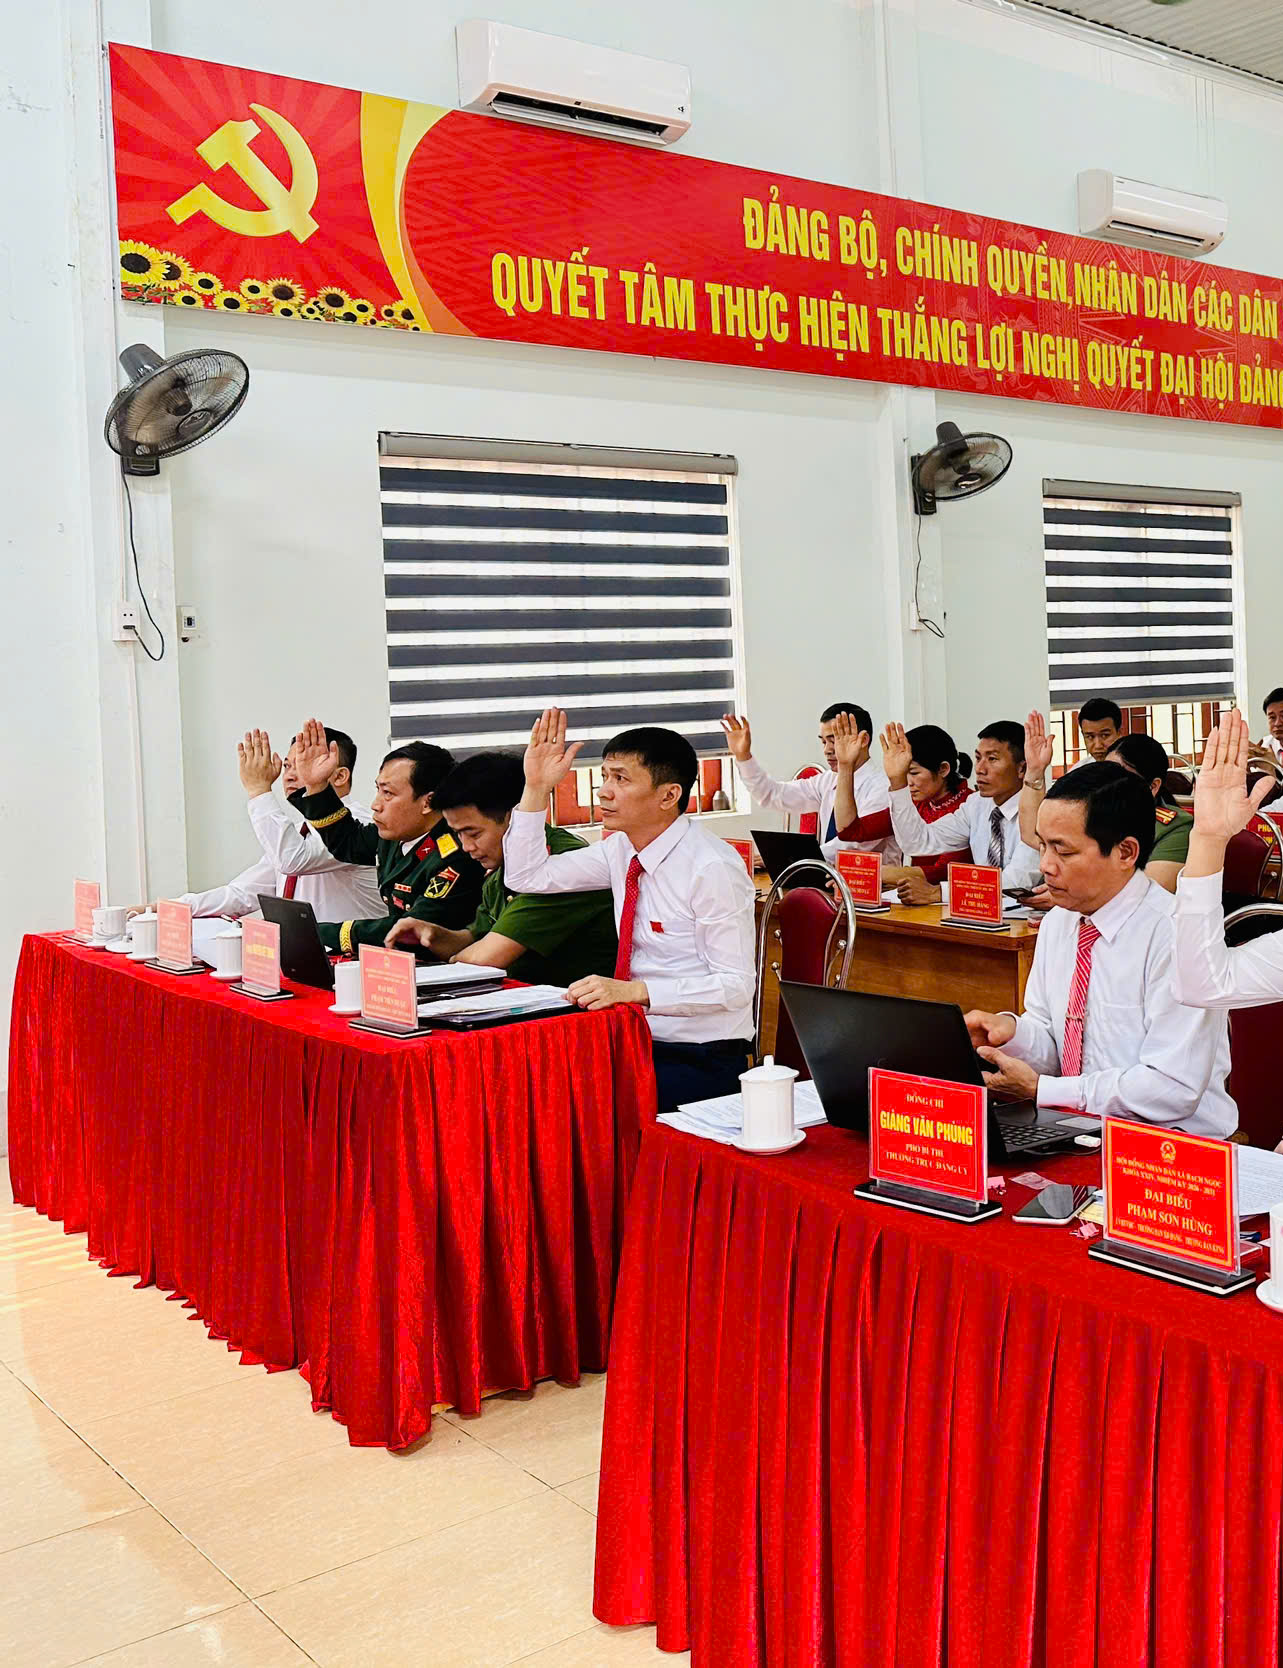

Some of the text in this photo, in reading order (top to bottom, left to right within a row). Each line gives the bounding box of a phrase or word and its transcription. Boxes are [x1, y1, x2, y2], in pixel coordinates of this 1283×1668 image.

[743, 185, 830, 261] ĐẢNG
[840, 210, 887, 280] BỘ,
[895, 223, 978, 287] CHÍNH
[987, 241, 1073, 310] QUYỀN,
[1074, 260, 1138, 315] NHÂN
[1144, 271, 1188, 324] DÂN
[1193, 280, 1233, 331] CÁC
[1239, 289, 1278, 339] DÂN
[491, 246, 608, 320] QUYẾT
[619, 262, 697, 332] TÂM
[705, 279, 789, 351] THỰC
[800, 292, 870, 361] HIỆN
[877, 299, 968, 366] THẮNG
[975, 322, 1014, 382] LỢI
[1022, 331, 1080, 392] NGHỊ
[1086, 335, 1154, 391] QUYẾT
[1160, 352, 1195, 404] ĐẠI
[1201, 352, 1234, 409] HỘI
[913, 1114, 935, 1139] VĂN
[1144, 1188, 1193, 1210] ĐẠI BIỂU
[1158, 1210, 1180, 1227] SƠN
[1181, 1215, 1213, 1237] HÙNG
